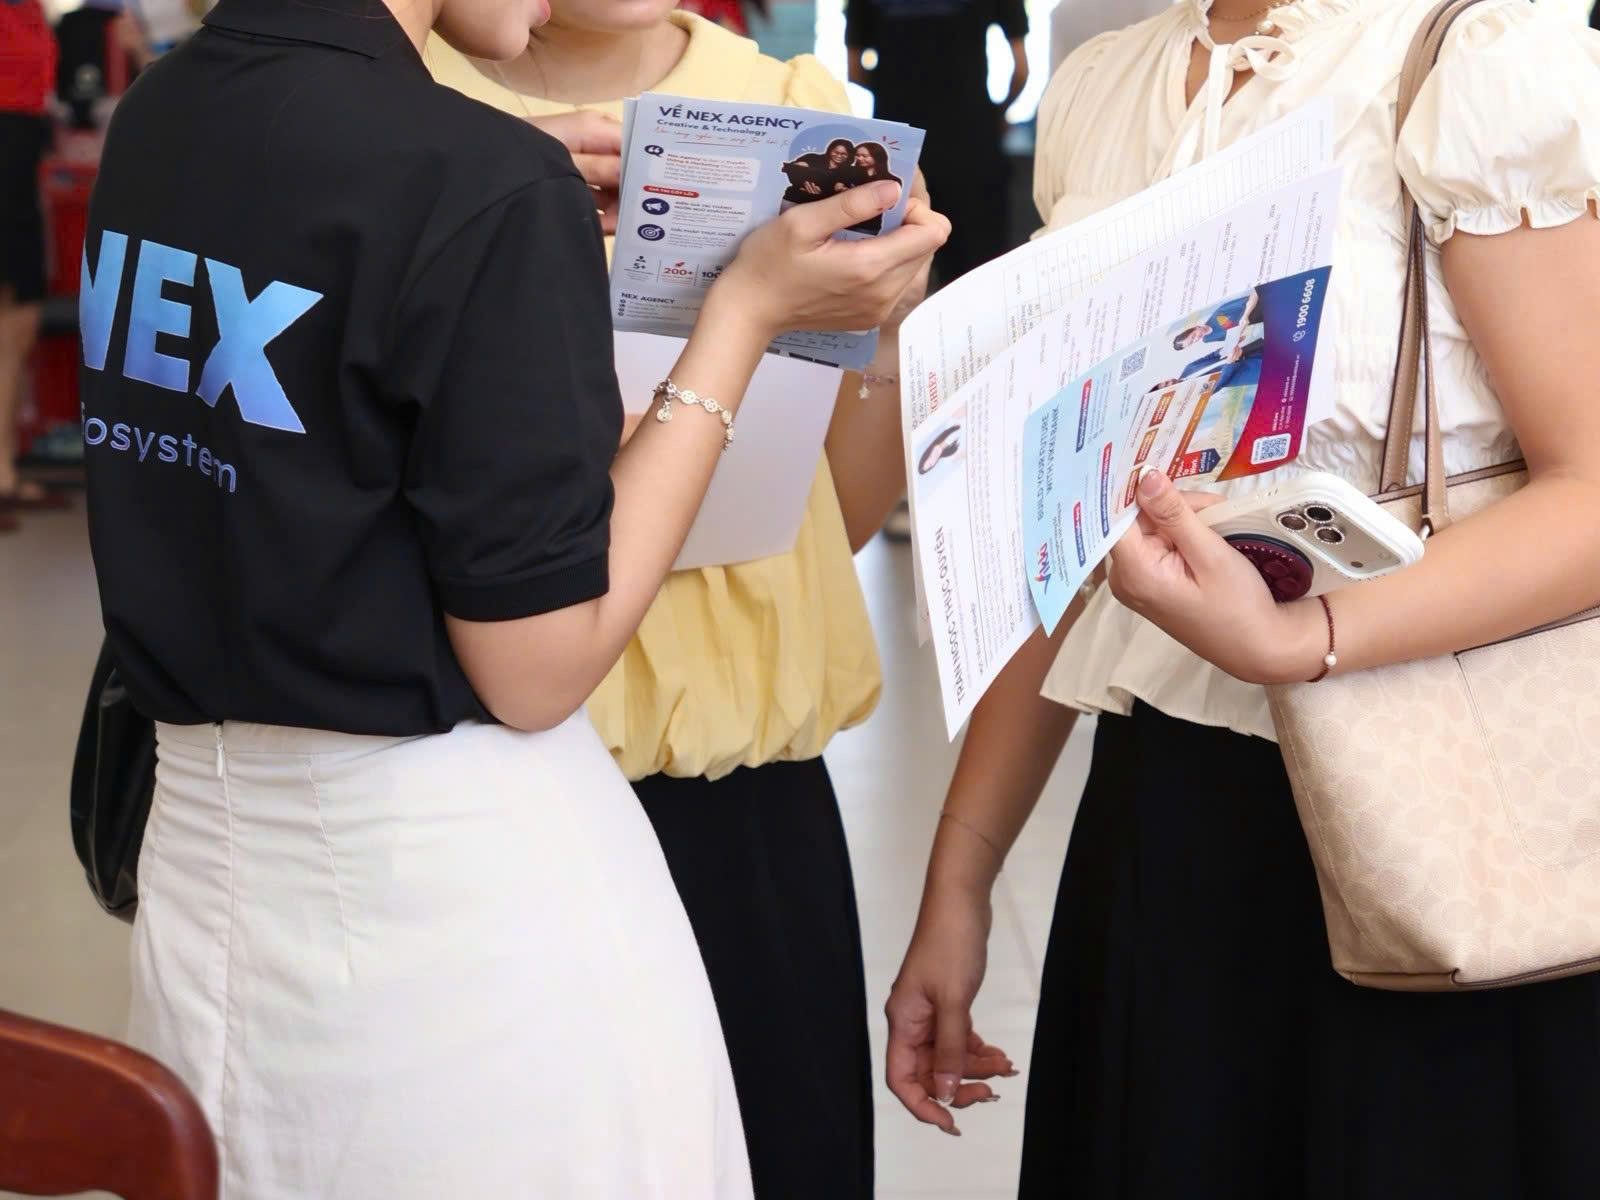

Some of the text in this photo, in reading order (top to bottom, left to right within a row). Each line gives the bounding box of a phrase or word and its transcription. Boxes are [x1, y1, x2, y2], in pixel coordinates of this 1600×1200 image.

[657, 119, 699, 130] Creative
[711, 125, 768, 137] Technology
[659, 104, 804, 130] VỀ NEX AGENCY
[663, 267, 693, 276] 200+
[641, 295, 675, 304] AGENCY
[1296, 278, 1316, 328] 1900 6608
[79, 230, 324, 434] NEX
[82, 413, 238, 493] osystem
